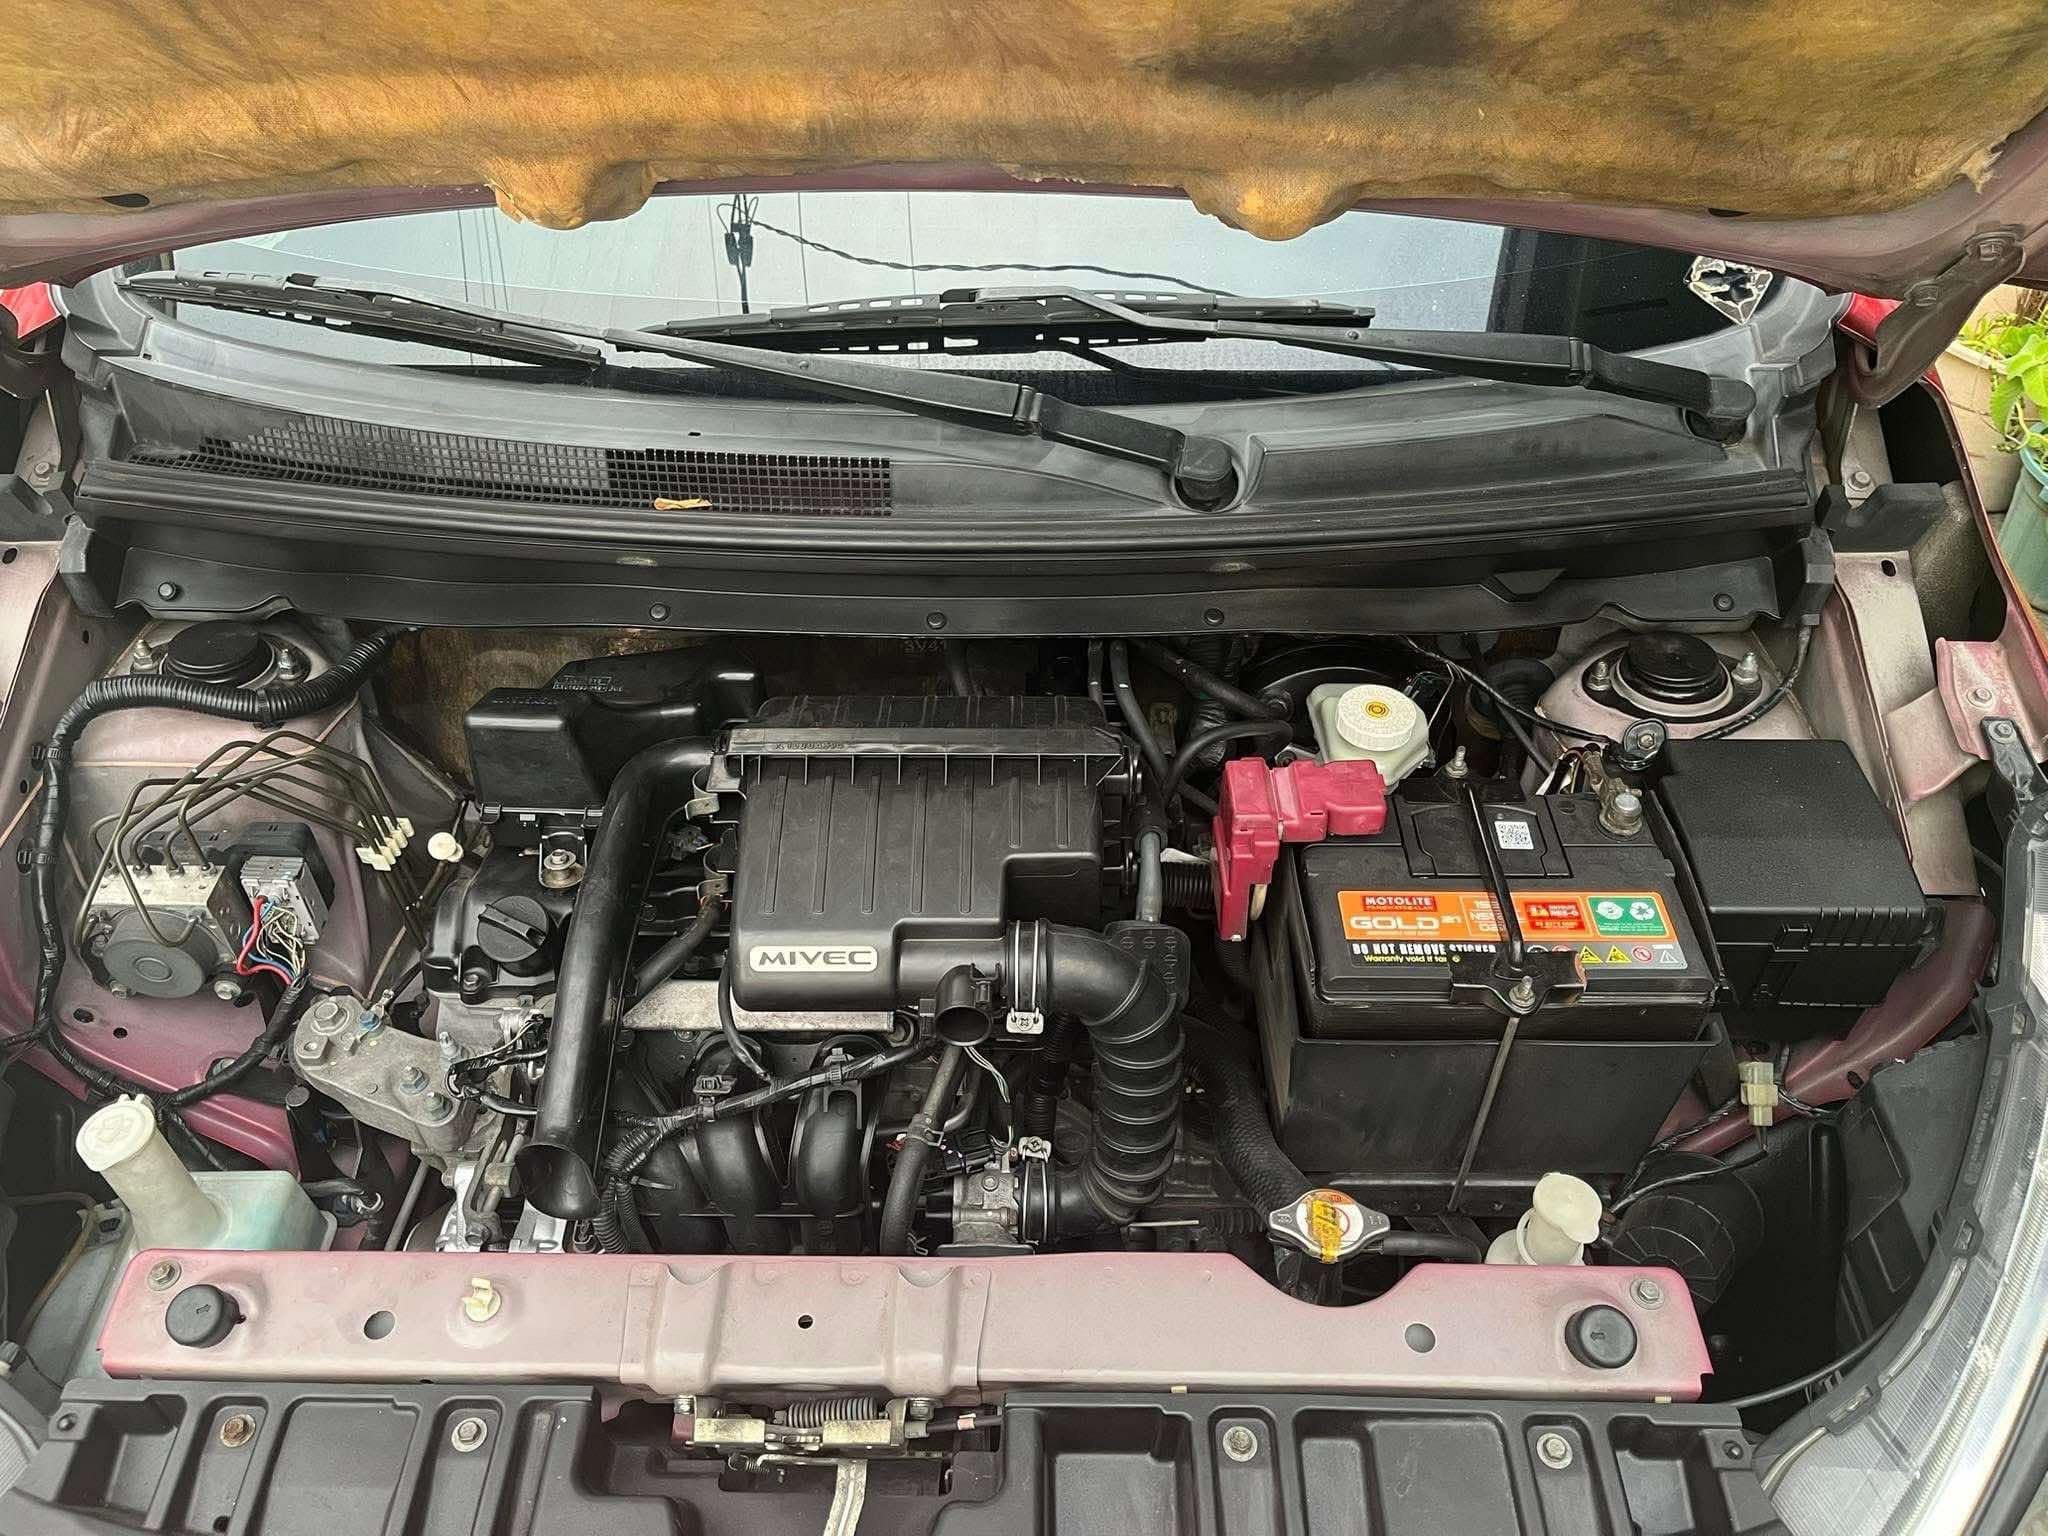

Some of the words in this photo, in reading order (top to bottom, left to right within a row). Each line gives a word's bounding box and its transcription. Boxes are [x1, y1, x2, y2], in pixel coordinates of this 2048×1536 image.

[1365, 896, 1433, 906] MOTOLITE
[1350, 915, 1440, 930] GOLD
[1352, 943, 1369, 955] DO
[1372, 943, 1395, 955] NOT
[1399, 943, 1447, 955] REMOVE
[759, 951, 872, 965] MIVEC
[1363, 954, 1404, 963] Warranty
[1405, 955, 1426, 963] void
